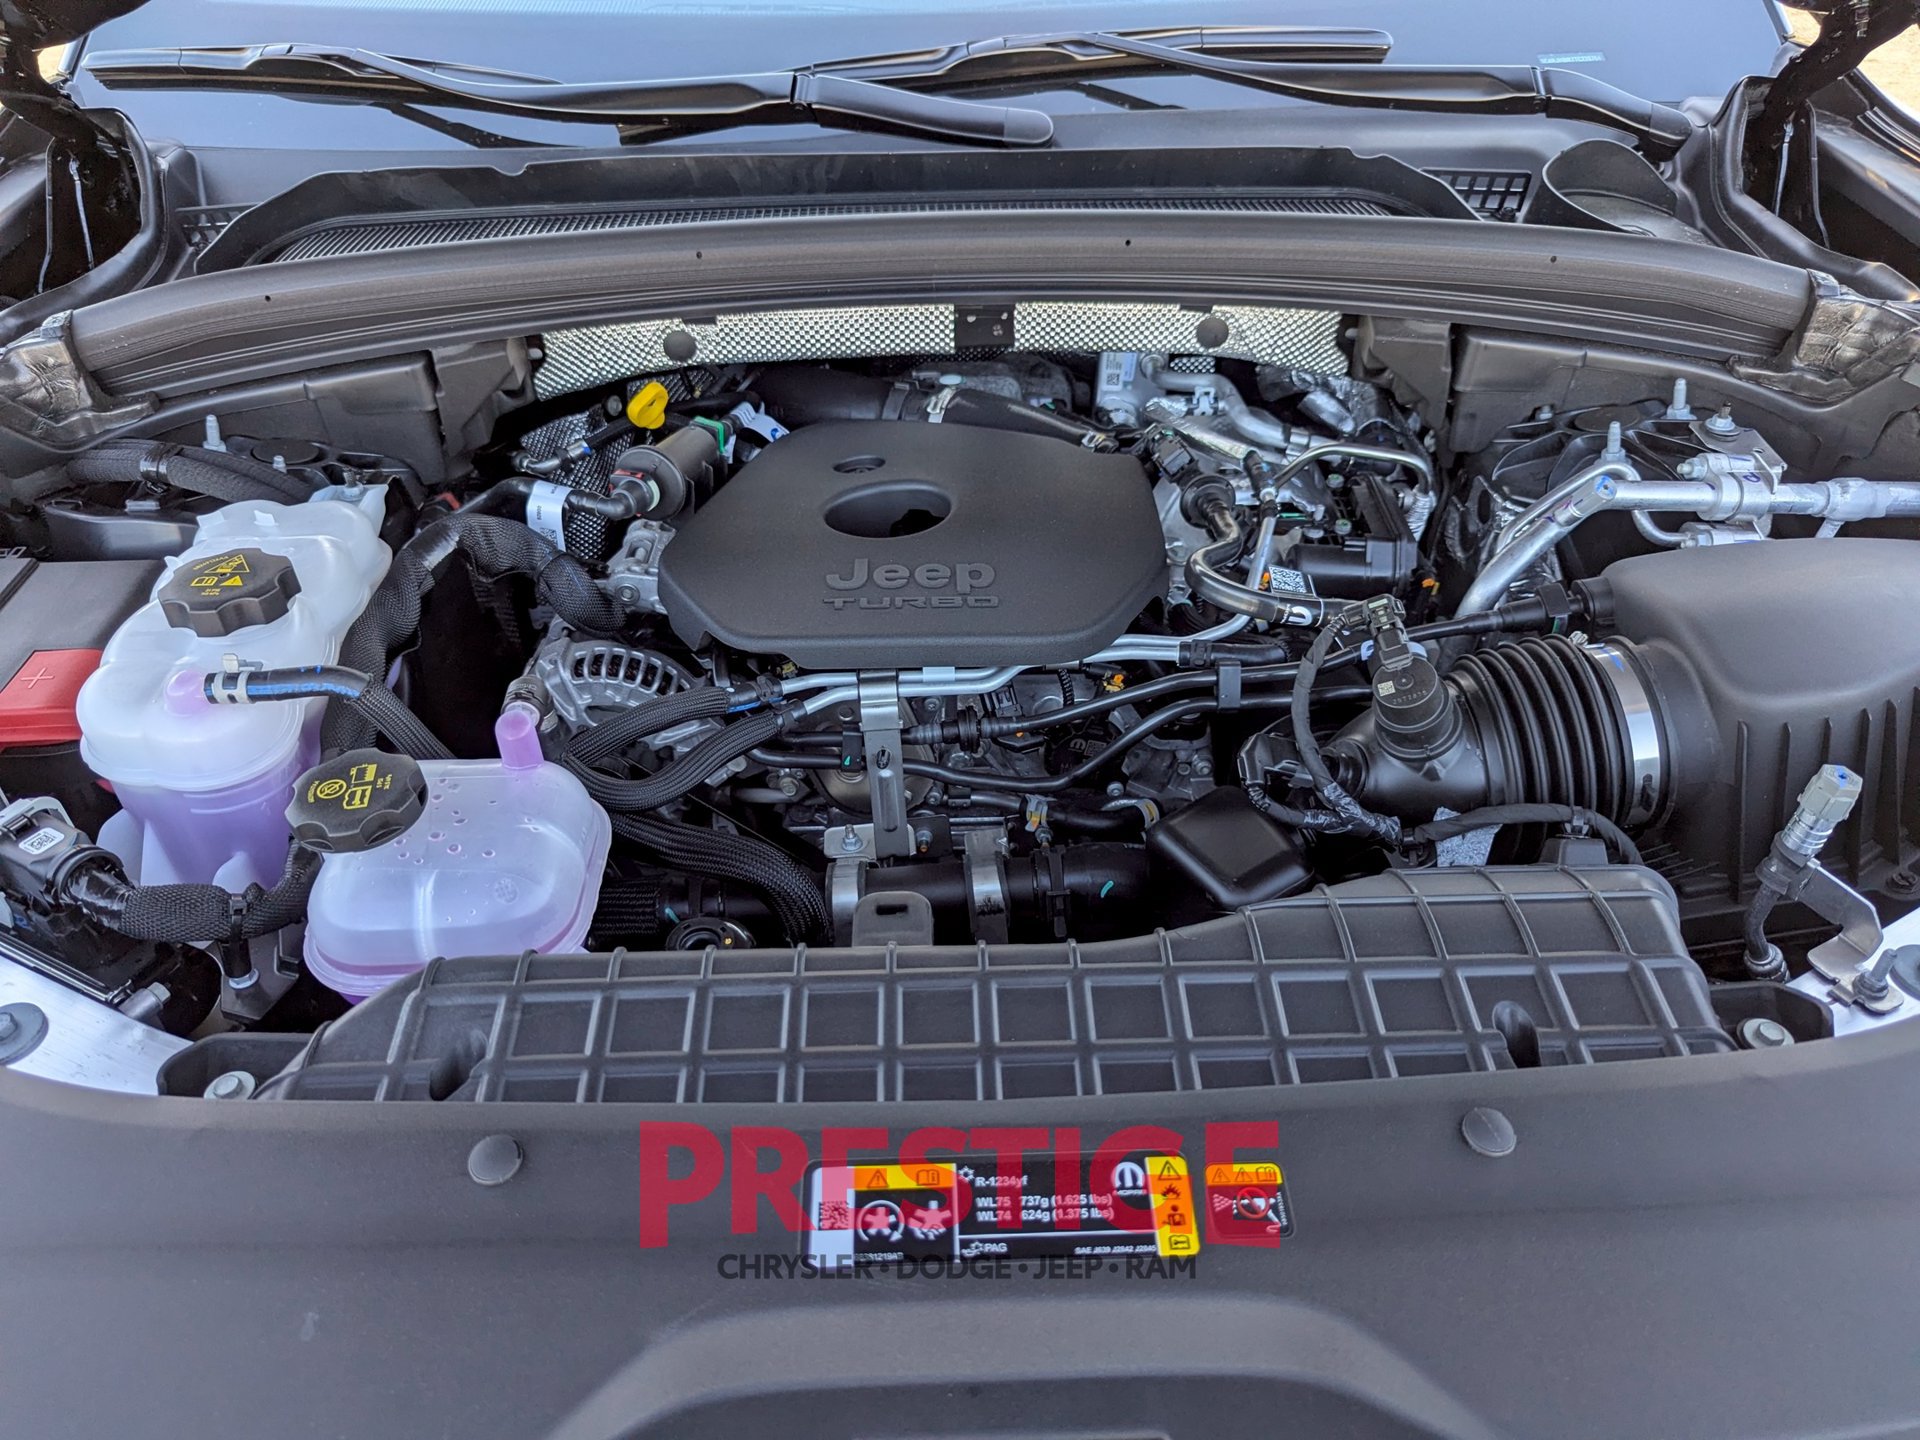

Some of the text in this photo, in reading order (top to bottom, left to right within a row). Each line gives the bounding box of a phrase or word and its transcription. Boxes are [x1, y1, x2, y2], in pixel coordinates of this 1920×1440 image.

[825, 558, 996, 595] Jeep
[823, 595, 999, 610] TURBO
[975, 1174, 1028, 1188] R-1234yf
[976, 1193, 1112, 1208] WL75 737g (1.625 lbs)
[977, 1207, 1115, 1222] WL74 624g (1.375 lbs)
[985, 1242, 1008, 1253] PAG
